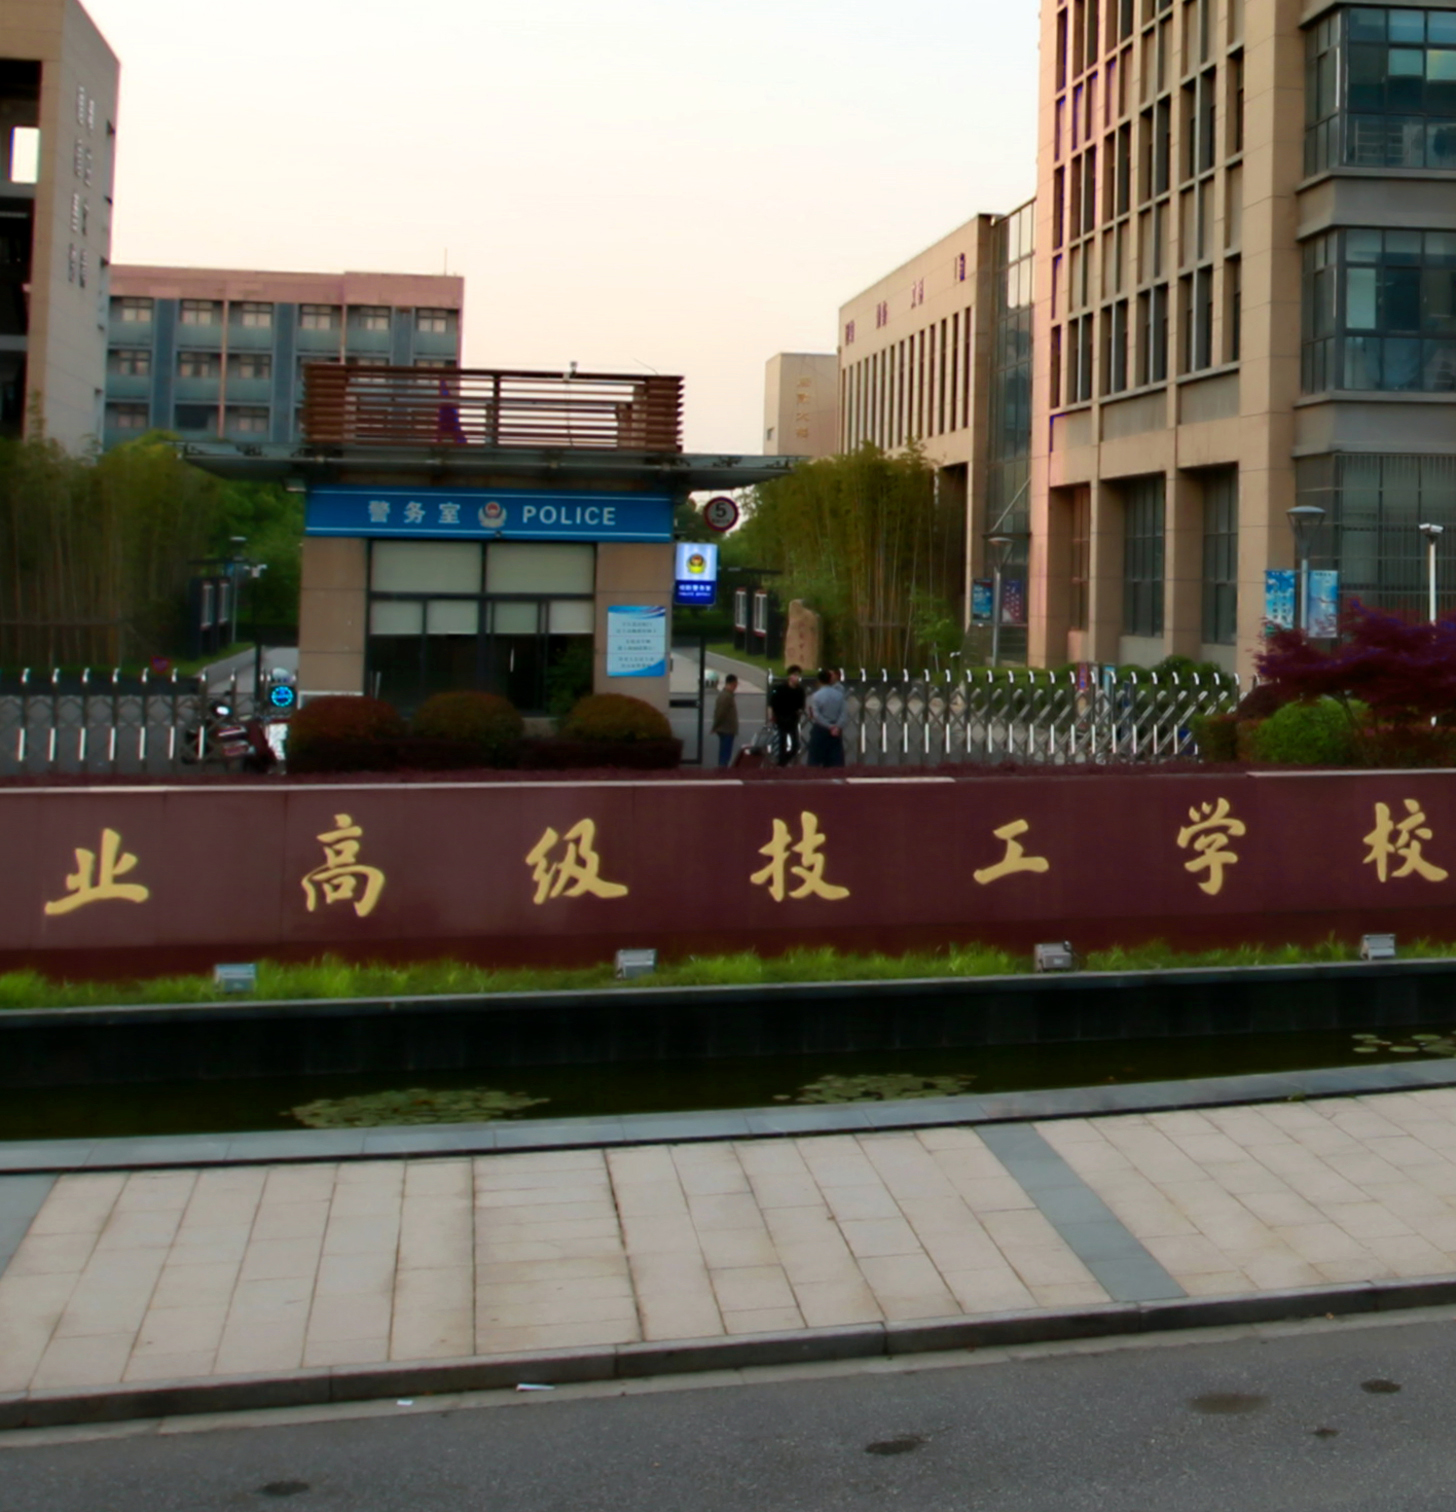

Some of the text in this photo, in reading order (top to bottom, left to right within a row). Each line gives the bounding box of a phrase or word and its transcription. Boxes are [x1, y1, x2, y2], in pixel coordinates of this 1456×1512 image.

[368, 500, 461, 524] 警务室
[522, 505, 616, 525] POLICE
[716, 502, 727, 518] 5
